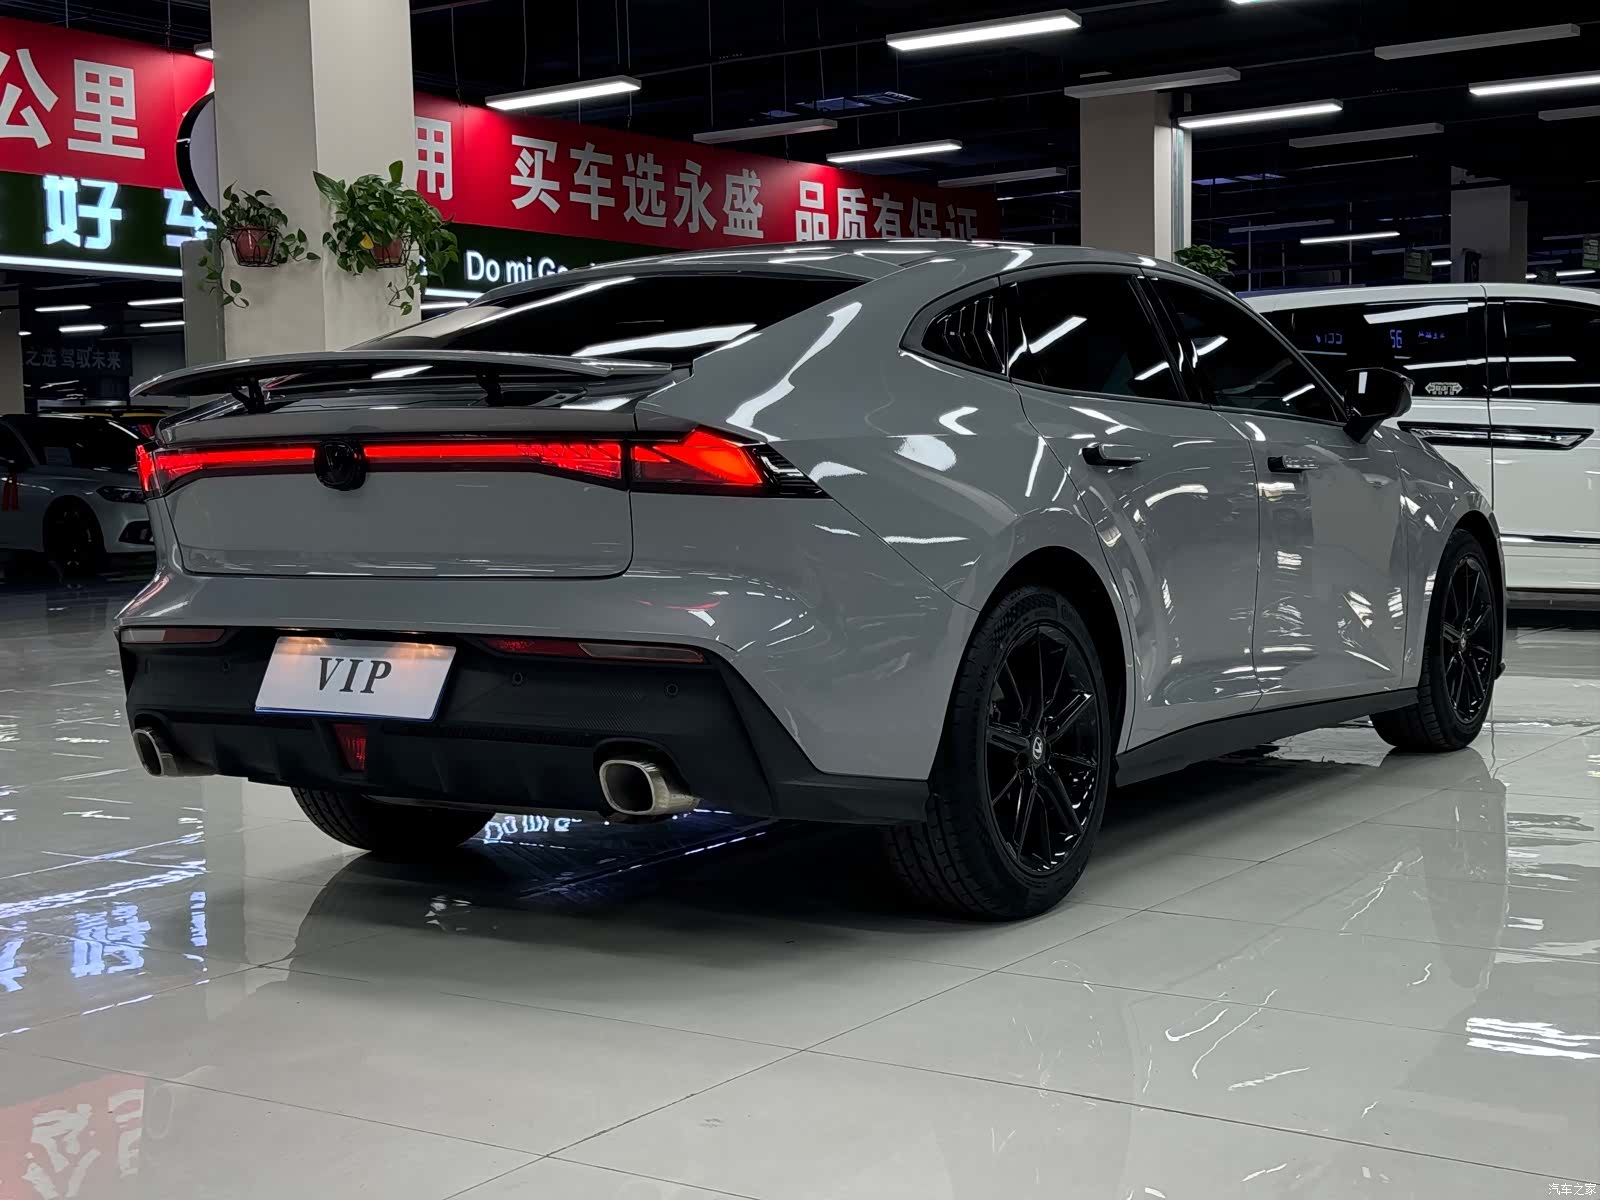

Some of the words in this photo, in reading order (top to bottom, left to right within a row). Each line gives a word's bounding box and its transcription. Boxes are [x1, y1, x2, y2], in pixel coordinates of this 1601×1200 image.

[0, 48, 146, 160] 公里
[510, 133, 764, 239] 买车选永盛
[795, 180, 979, 242] 品质有保证
[466, 250, 501, 283] Do
[60, 347, 121, 370] 驾驭未来
[318, 656, 392, 694] VIP
